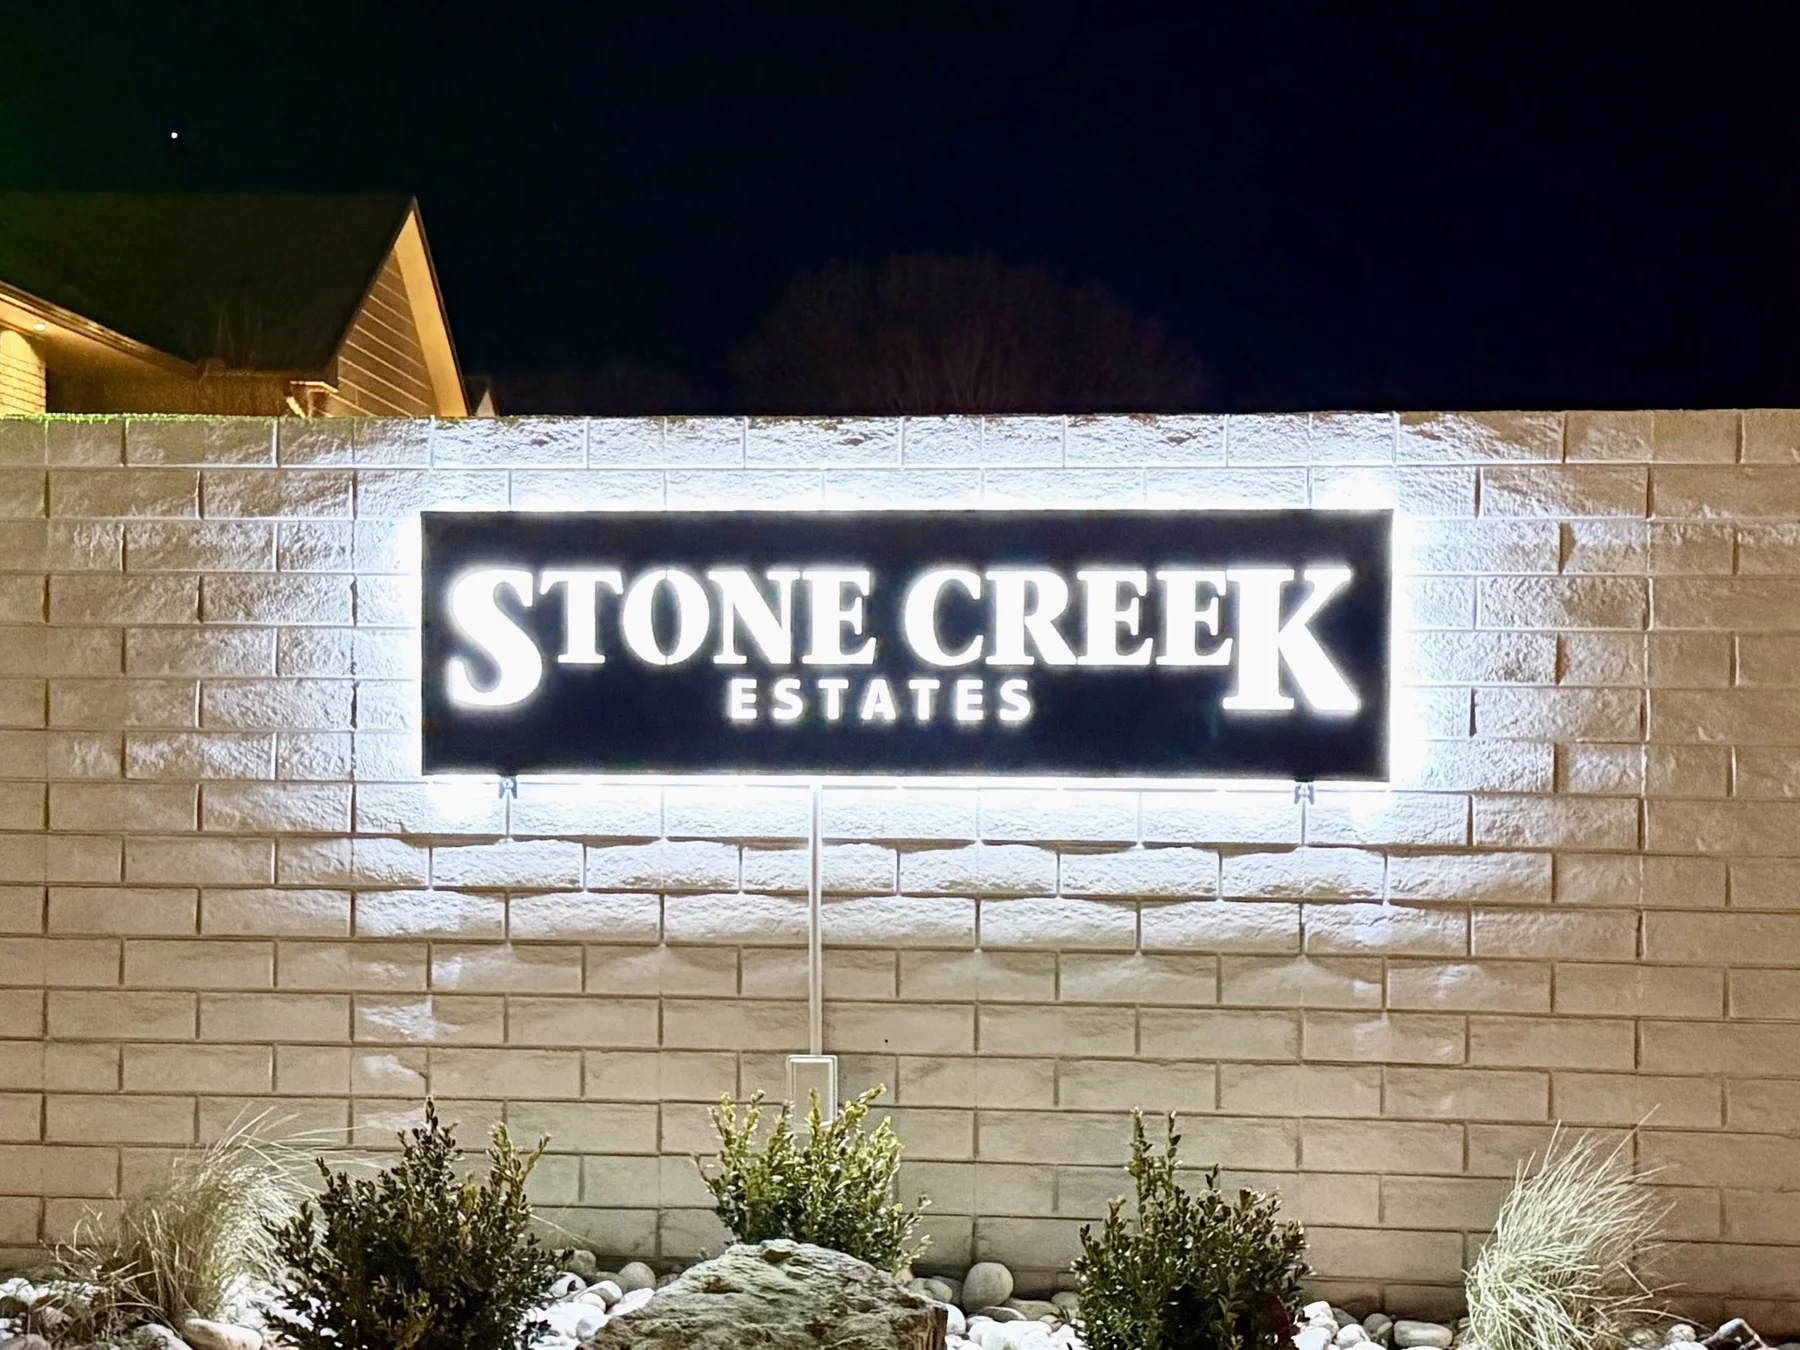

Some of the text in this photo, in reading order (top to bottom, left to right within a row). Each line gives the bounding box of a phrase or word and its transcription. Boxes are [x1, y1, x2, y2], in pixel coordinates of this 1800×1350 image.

[444, 564, 1361, 717] STONE CREEK
[727, 676, 1034, 725] ESTATES
